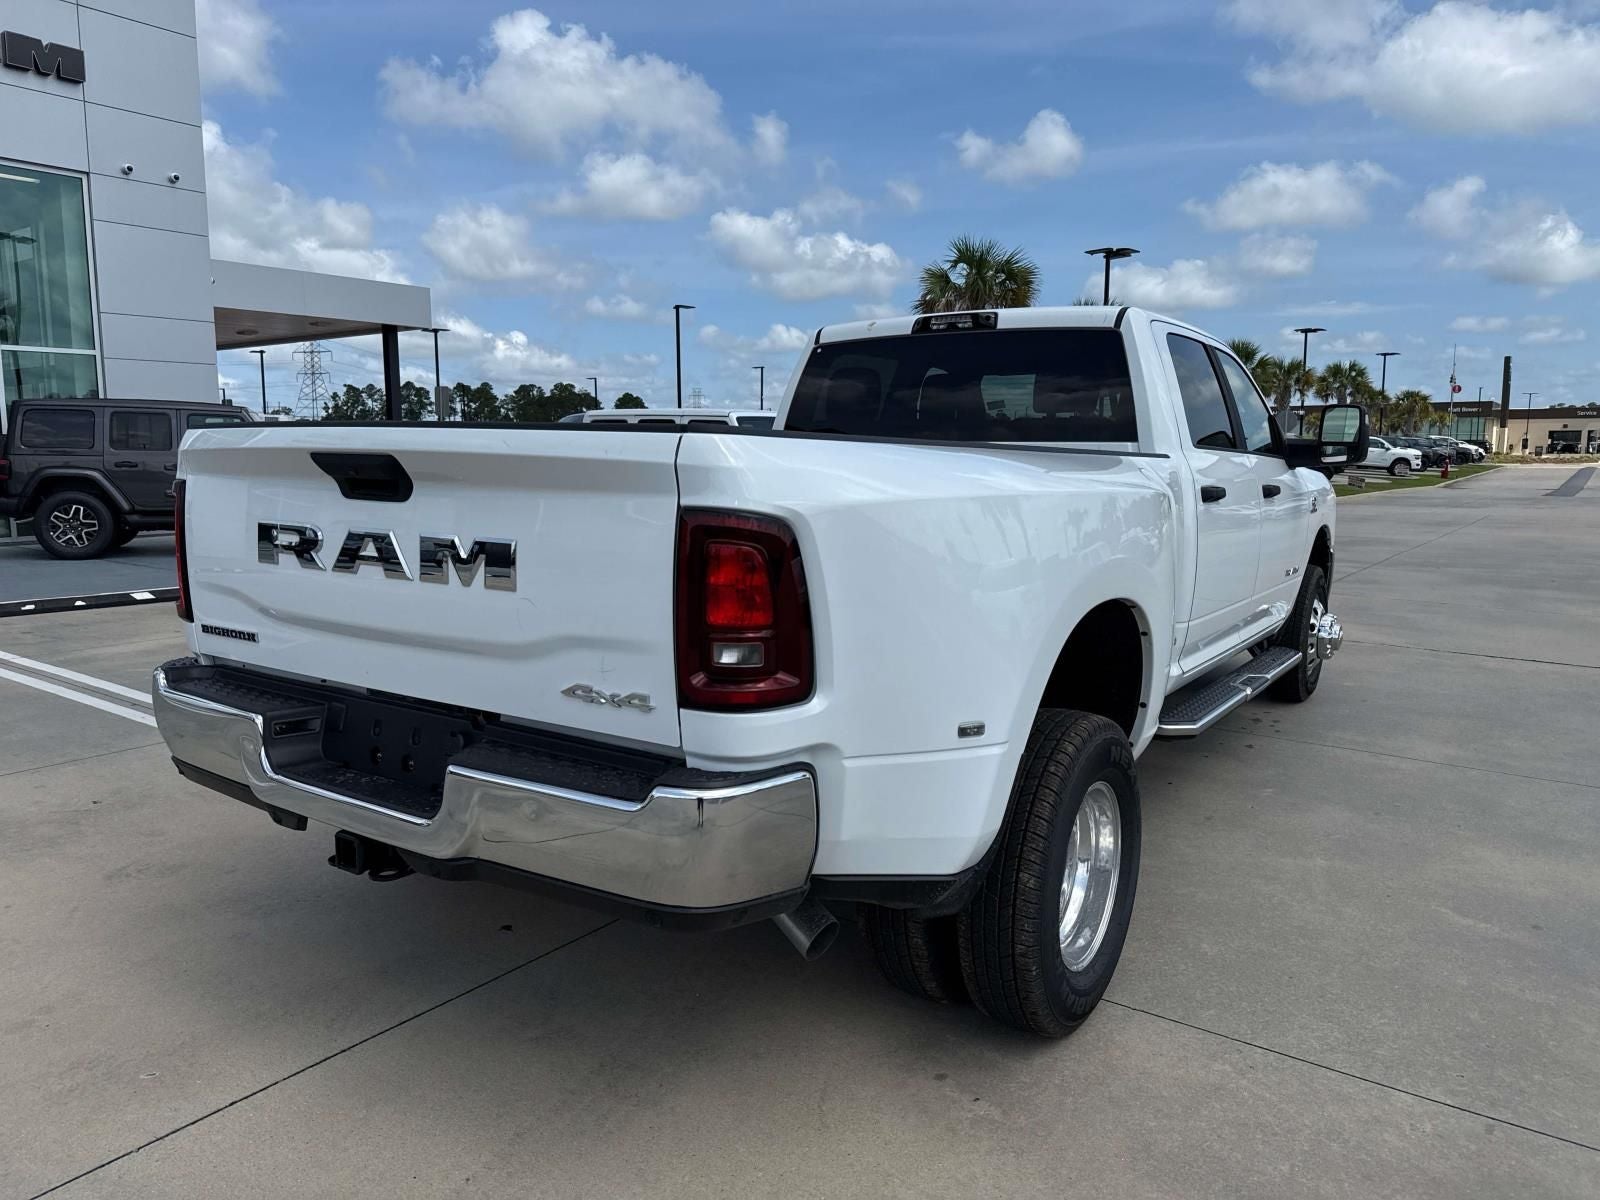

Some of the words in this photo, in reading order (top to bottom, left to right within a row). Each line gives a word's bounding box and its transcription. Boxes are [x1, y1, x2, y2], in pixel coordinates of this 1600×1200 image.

[0, 30, 87, 83] M
[257, 520, 517, 592] RAM
[201, 624, 259, 643] BIGHORN
